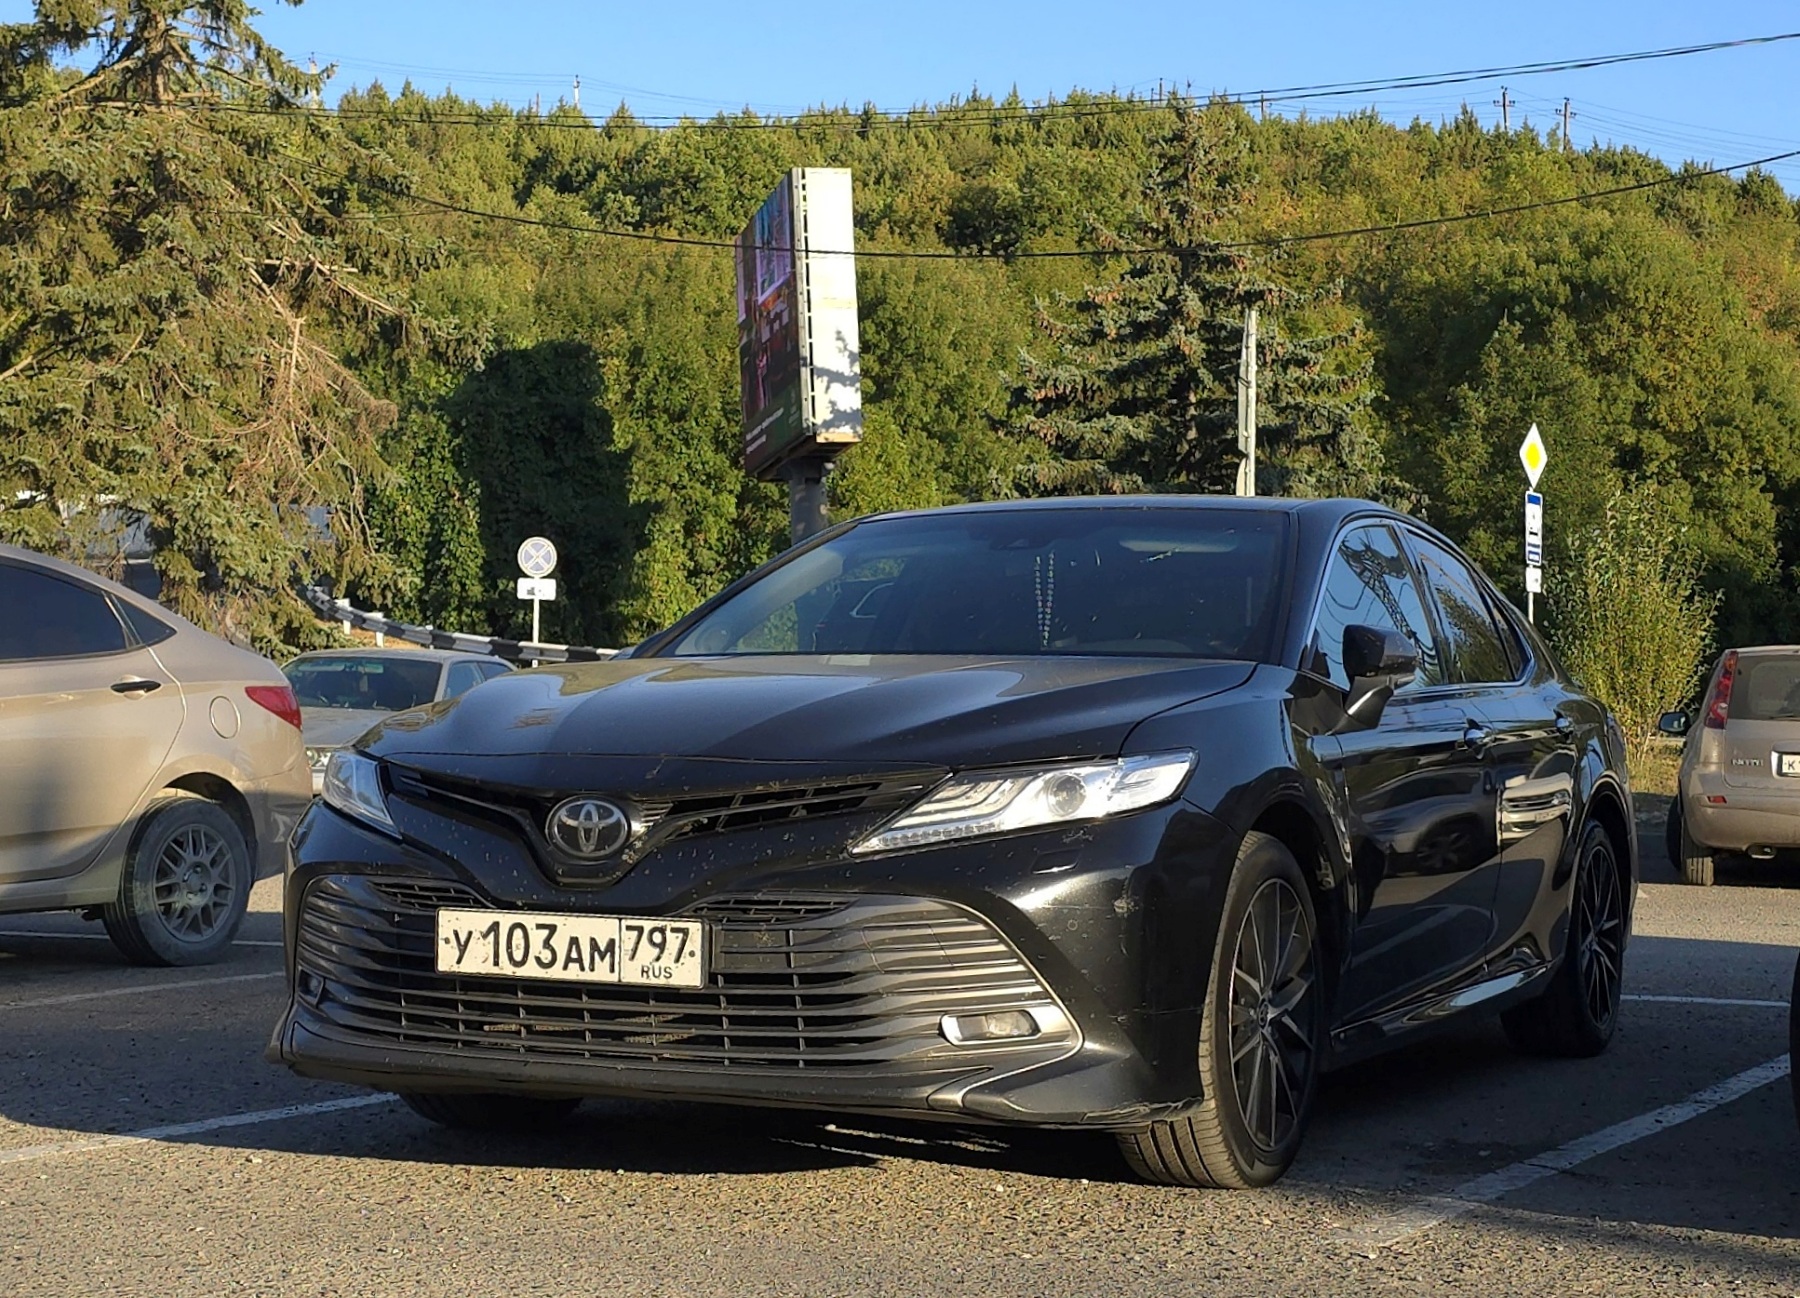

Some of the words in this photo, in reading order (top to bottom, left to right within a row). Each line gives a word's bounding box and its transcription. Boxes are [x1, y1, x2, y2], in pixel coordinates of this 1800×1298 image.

[452, 920, 616, 974] У103АМ
[625, 925, 690, 964] 797
[641, 965, 673, 979] RUS
